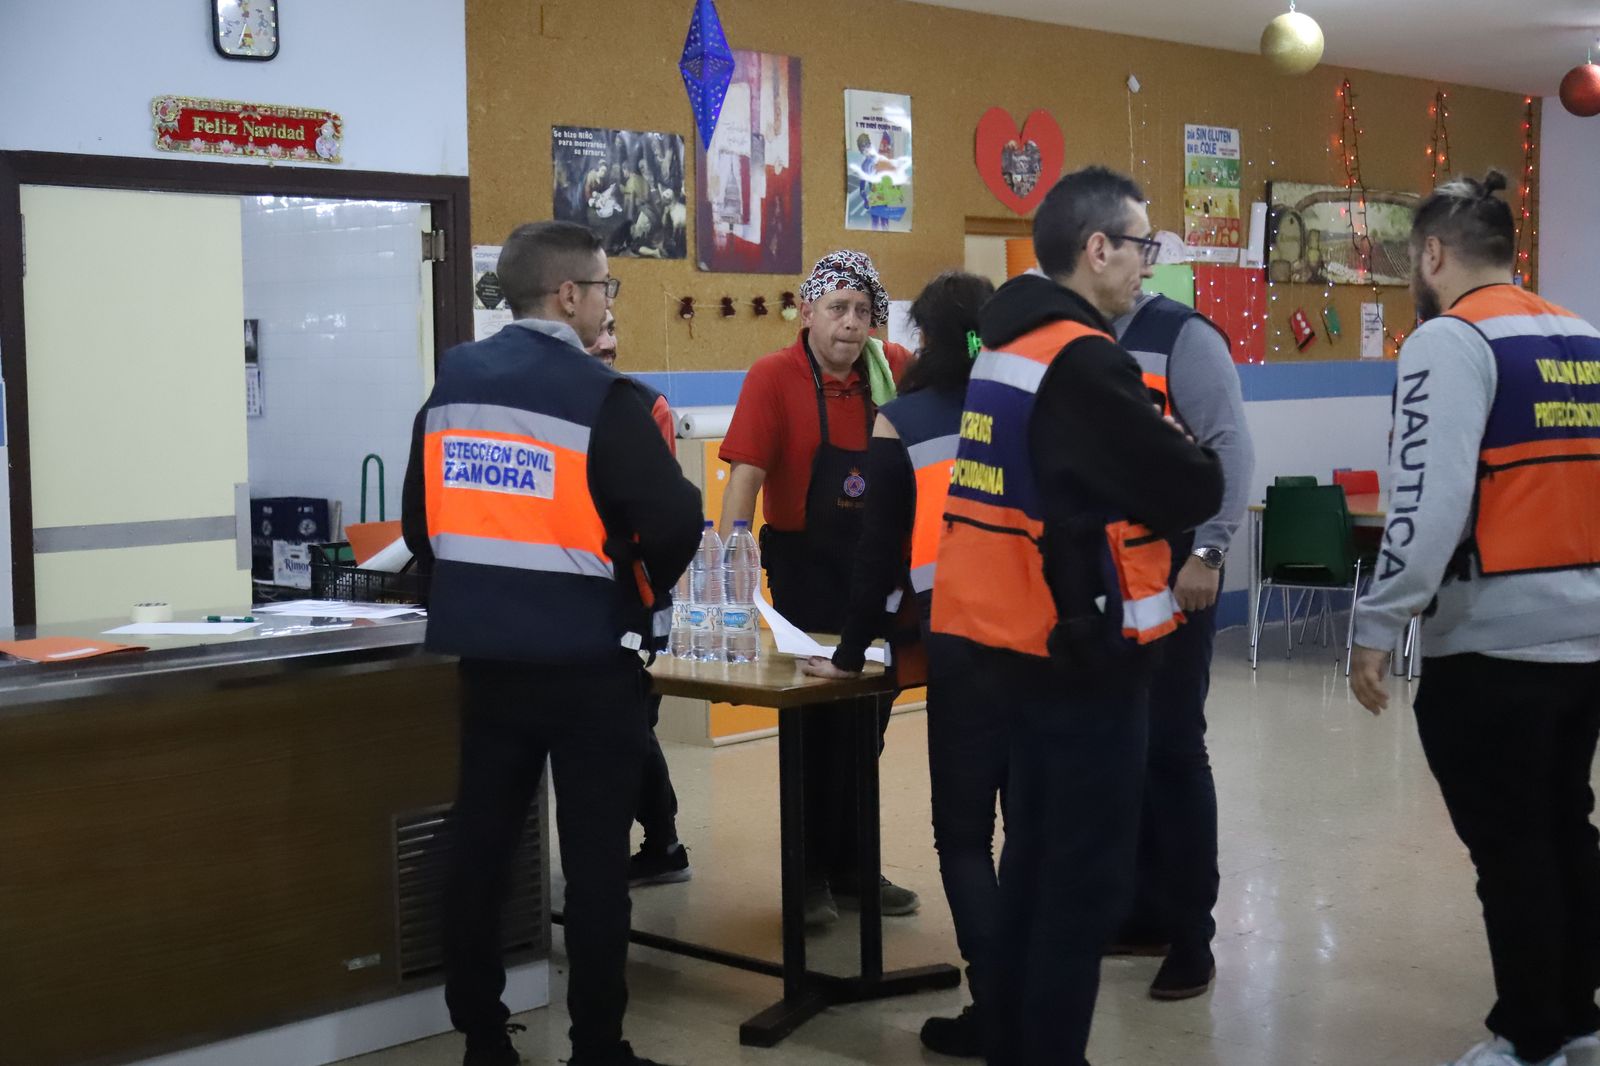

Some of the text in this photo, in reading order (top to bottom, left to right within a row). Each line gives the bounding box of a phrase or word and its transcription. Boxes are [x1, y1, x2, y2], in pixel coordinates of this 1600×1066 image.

[192, 116, 305, 141] Feliz Navidad
[1207, 129, 1232, 143] GLUTEN
[516, 448, 552, 473] CIVIL
[444, 460, 536, 491] ZAMORA
[1378, 369, 1431, 582] NAUTICA
